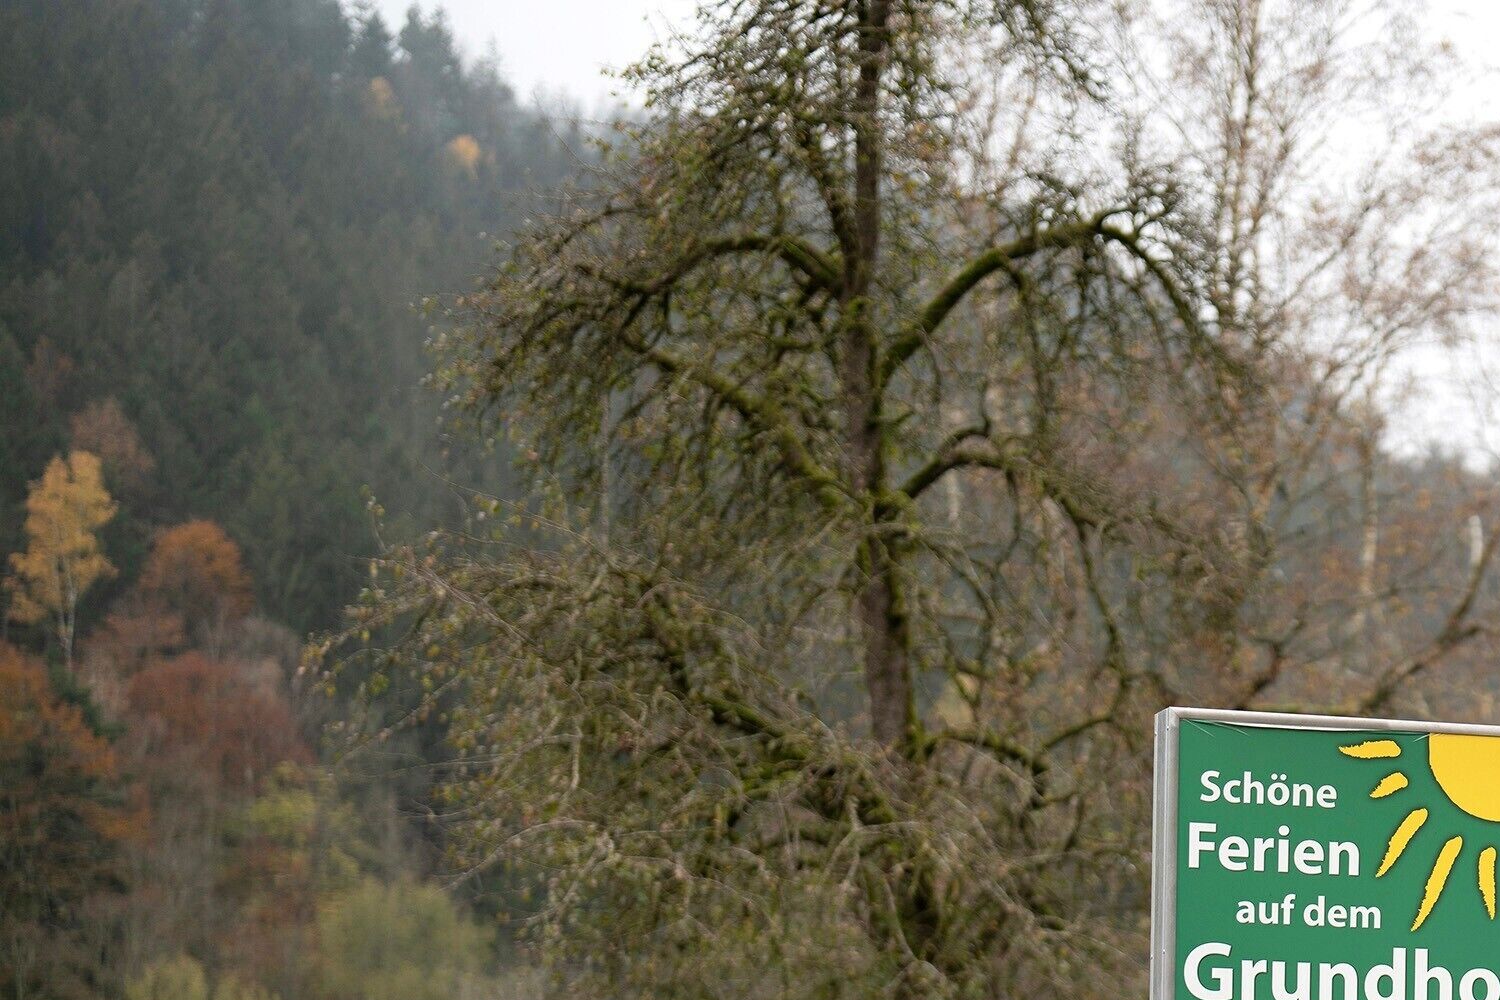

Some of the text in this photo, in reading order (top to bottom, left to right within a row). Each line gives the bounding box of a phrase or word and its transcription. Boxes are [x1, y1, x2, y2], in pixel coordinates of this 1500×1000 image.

[1199, 770, 1338, 809] Schöne
[1187, 821, 1361, 877] Ferien
[1235, 893, 1382, 929] auf dem
